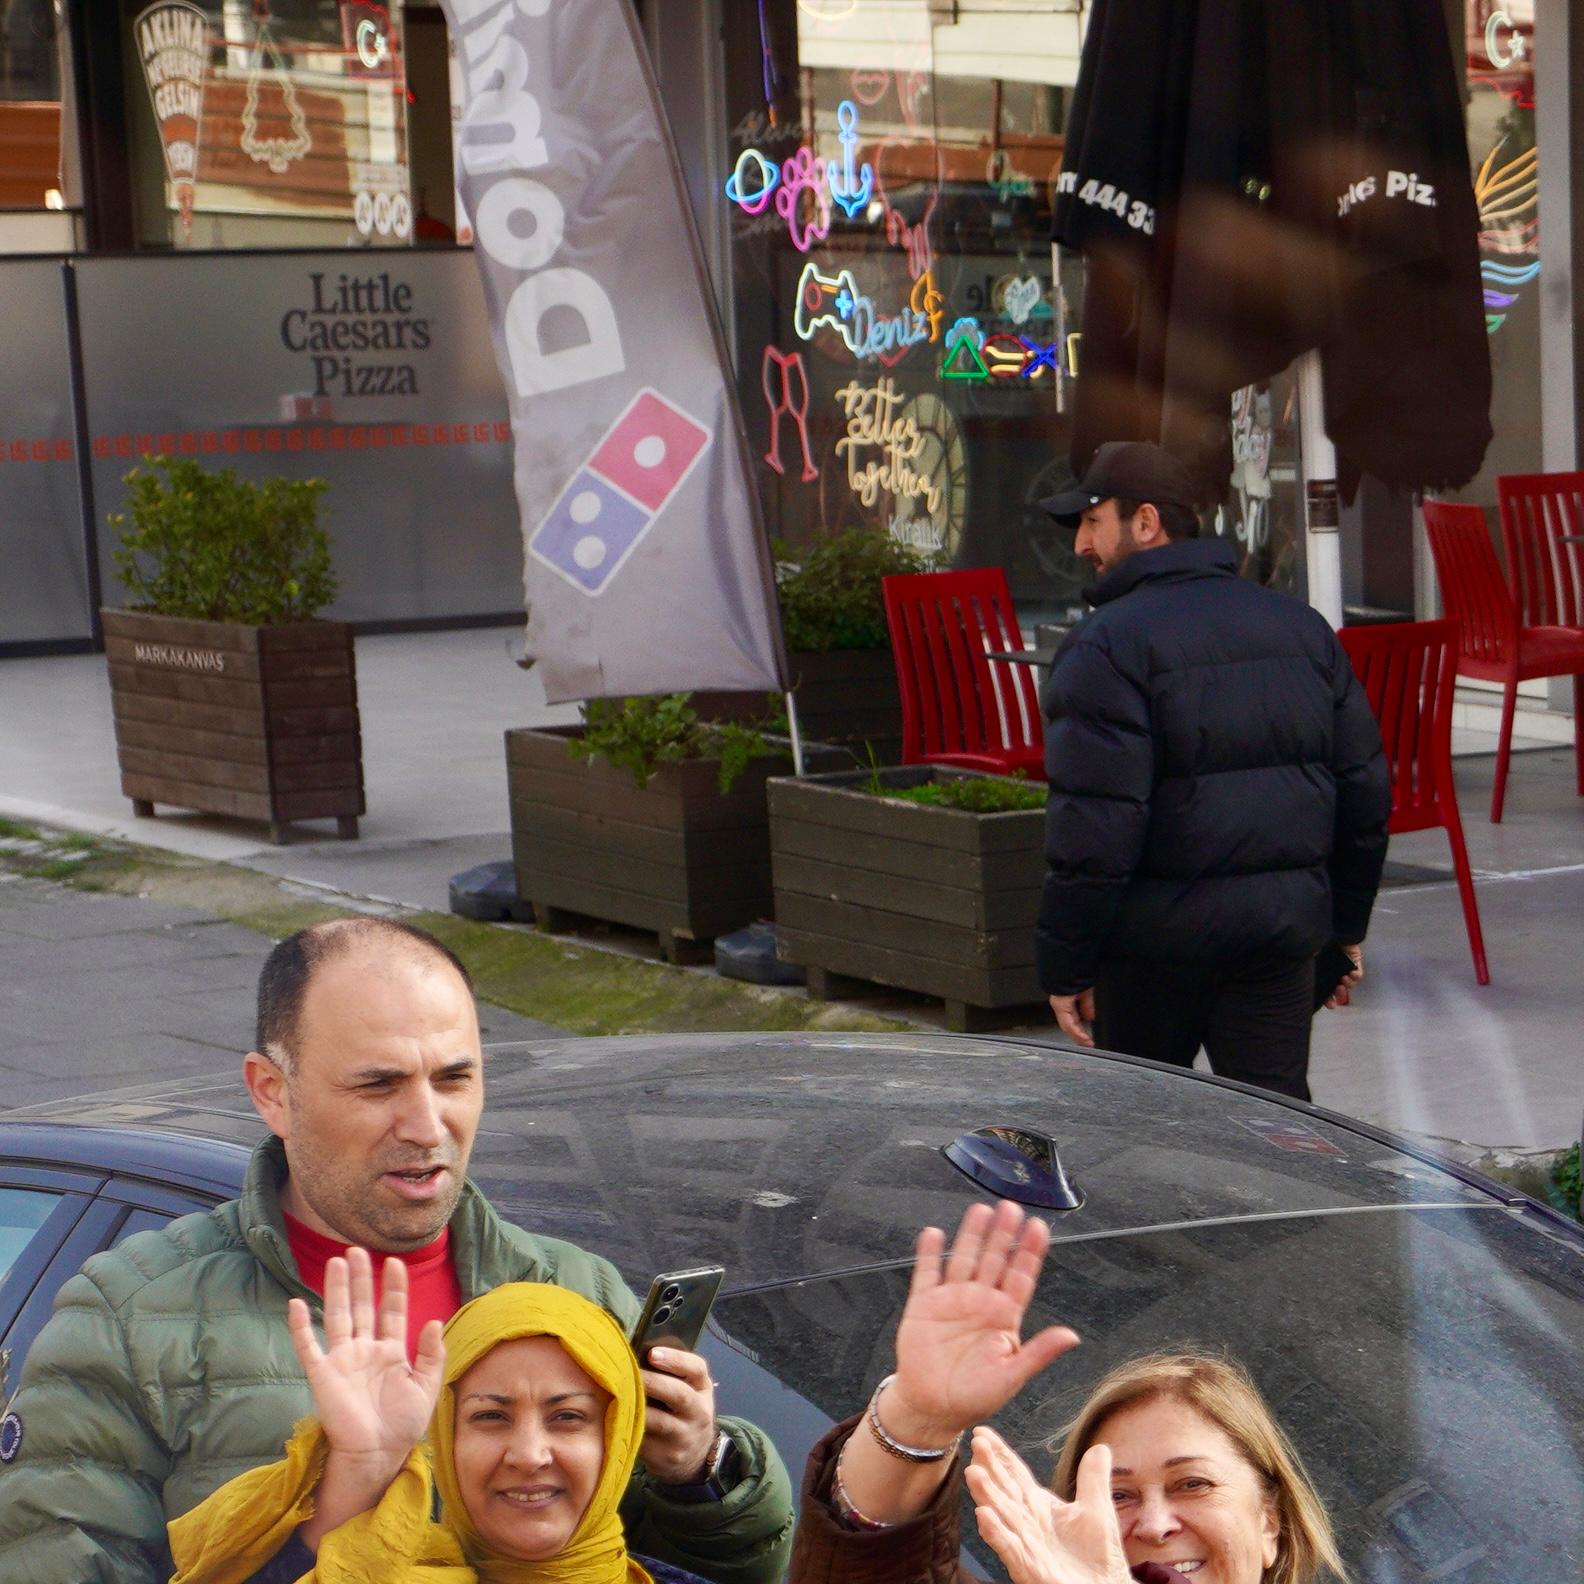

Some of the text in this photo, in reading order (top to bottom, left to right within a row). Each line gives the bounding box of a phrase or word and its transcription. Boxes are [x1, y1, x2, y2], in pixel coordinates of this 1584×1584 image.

[1385, 170, 1438, 208] Piz
[310, 272, 413, 315] Little
[280, 309, 431, 353] Caesars
[311, 355, 419, 397] Pizza
[135, 645, 225, 672] MARKAKANVAS
